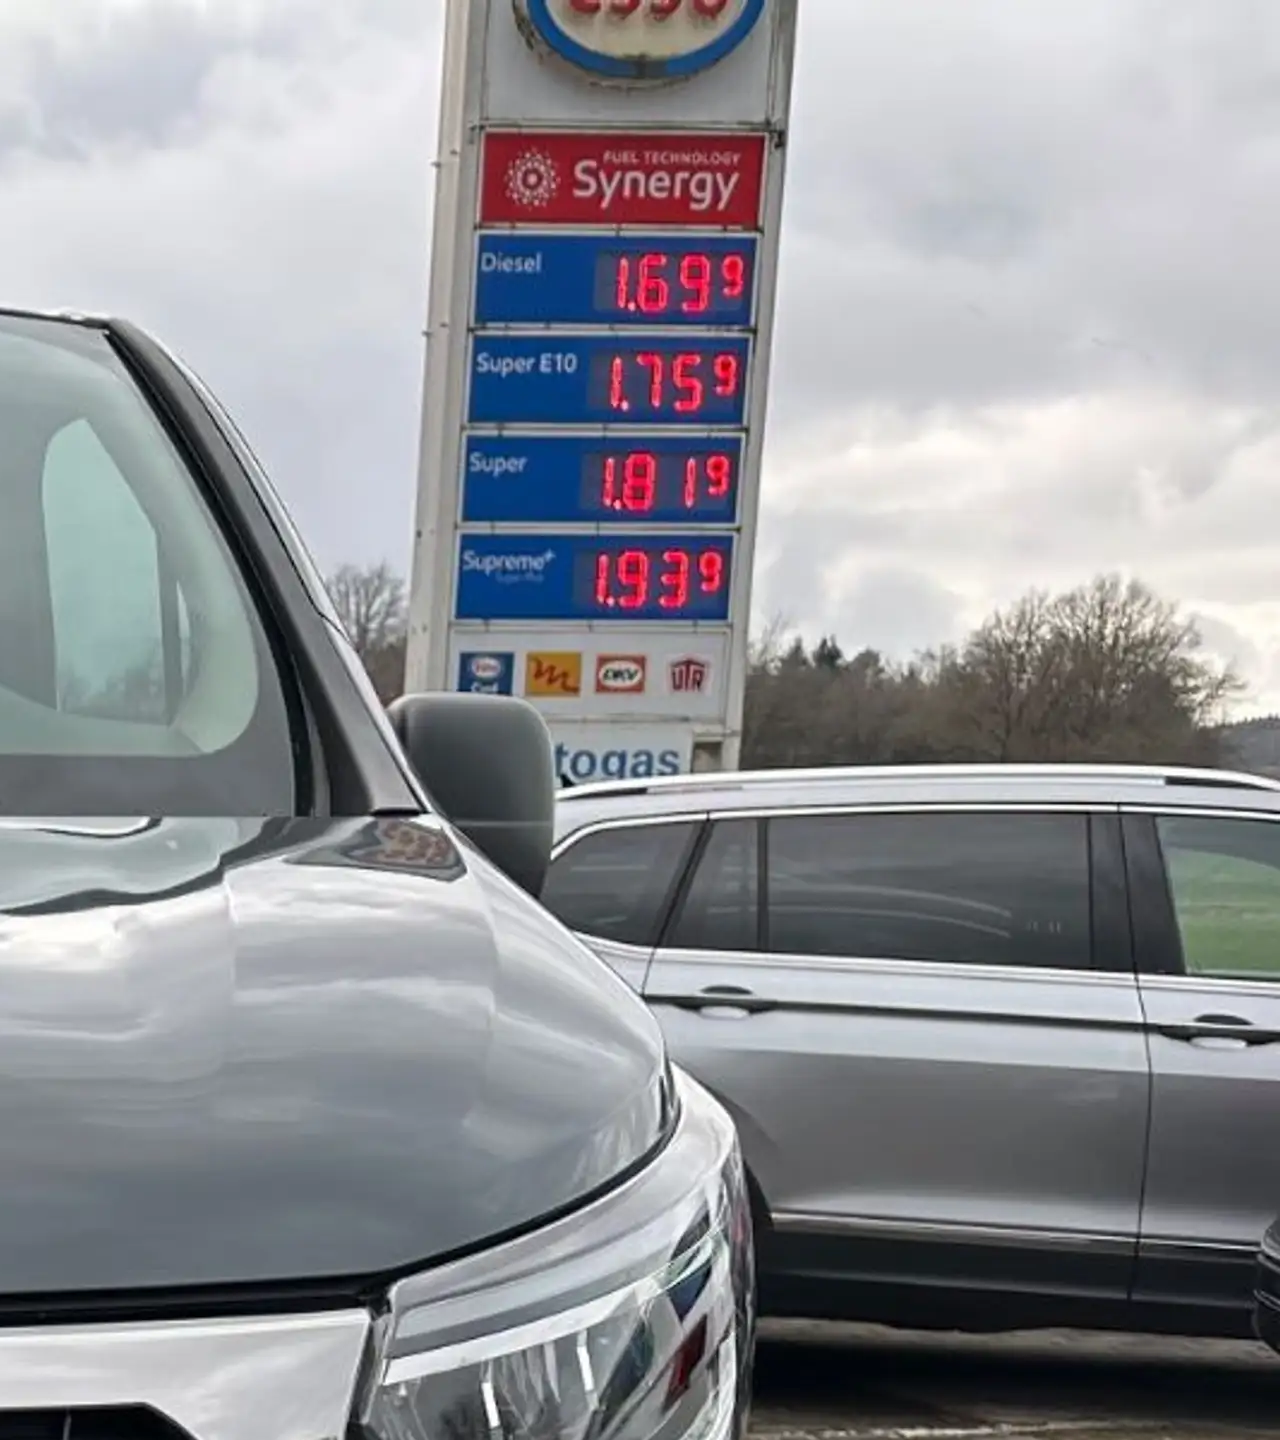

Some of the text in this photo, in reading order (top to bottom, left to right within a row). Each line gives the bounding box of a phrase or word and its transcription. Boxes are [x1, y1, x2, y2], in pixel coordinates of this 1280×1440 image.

[603, 150, 741, 165] FUEL TECHNOLOGY
[572, 159, 740, 211] Synergy
[480, 253, 541, 273] Diesel
[476, 353, 578, 378] Super E10
[469, 453, 528, 478] Super
